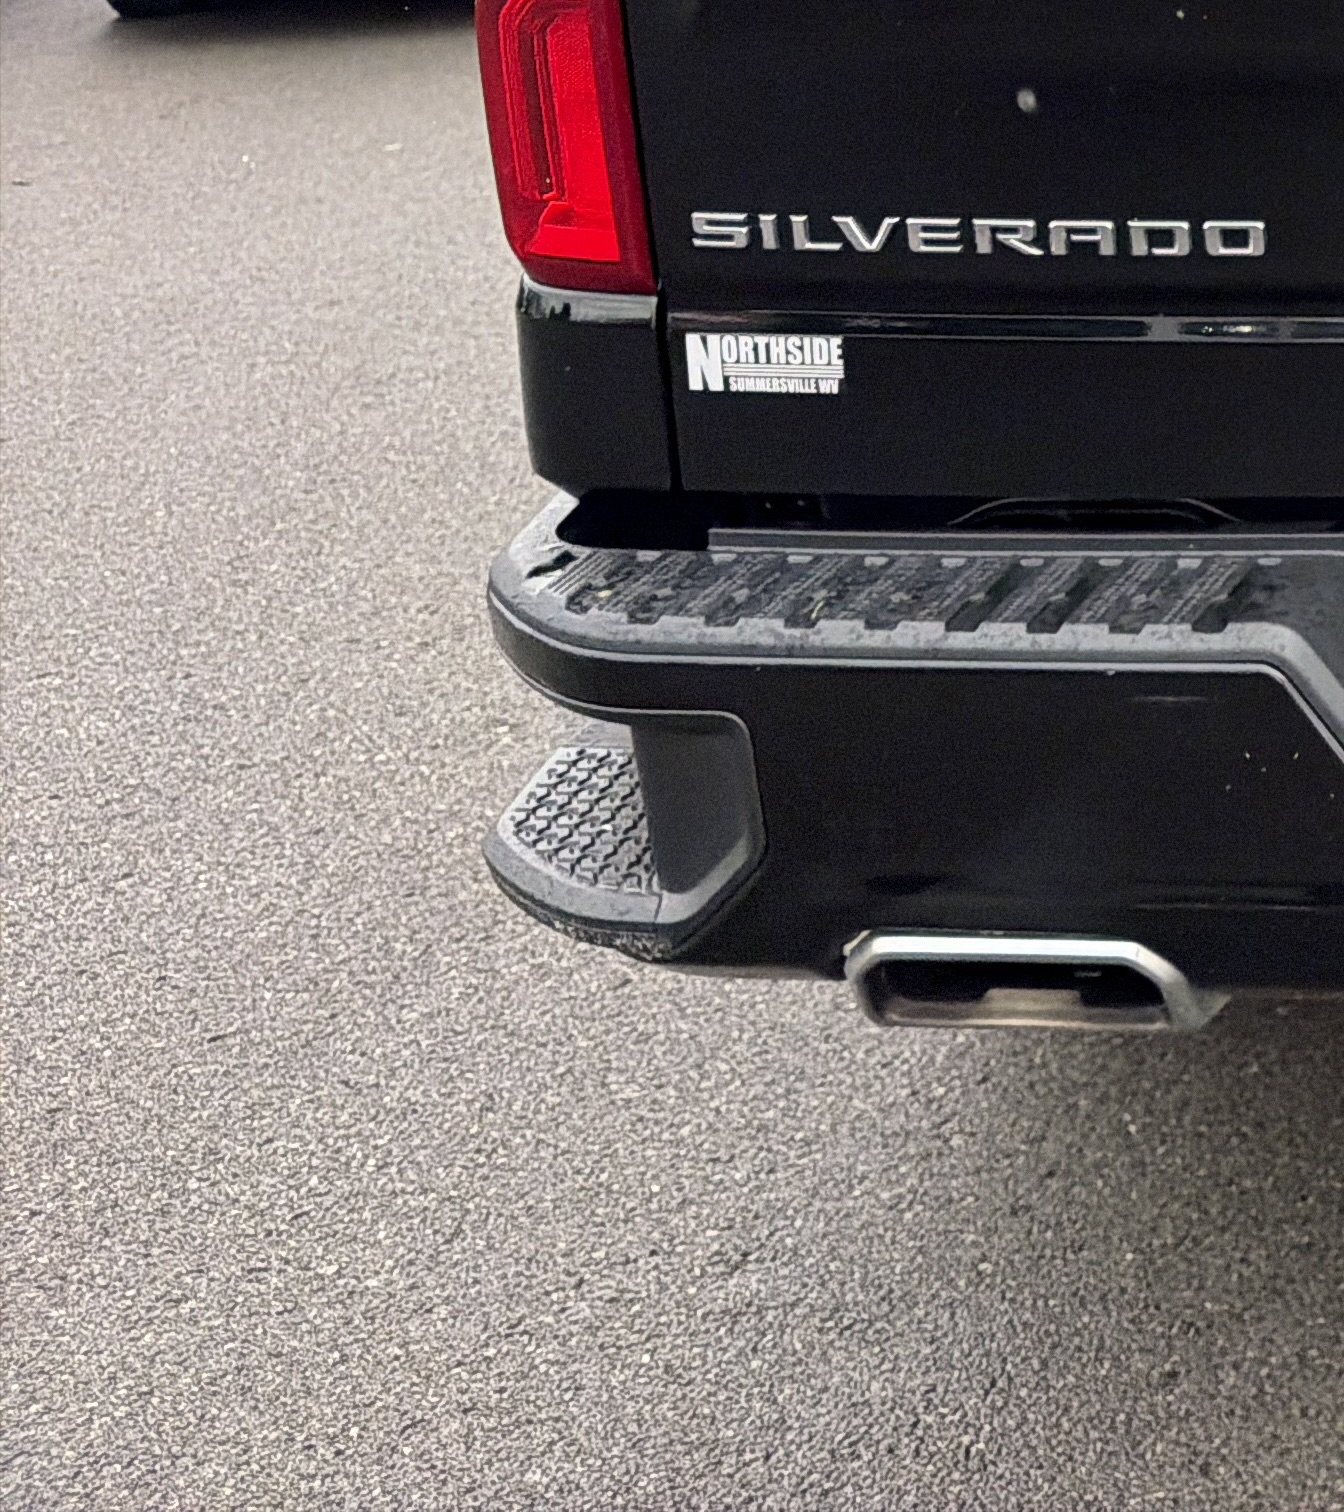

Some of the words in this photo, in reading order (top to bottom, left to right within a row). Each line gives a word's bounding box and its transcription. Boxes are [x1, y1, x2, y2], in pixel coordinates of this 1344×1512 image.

[690, 211, 1266, 257] SILVERADO
[685, 333, 844, 391] NORTHSIDE
[729, 375, 817, 394] SUMMERSVILLE
[818, 378, 840, 395] WV
